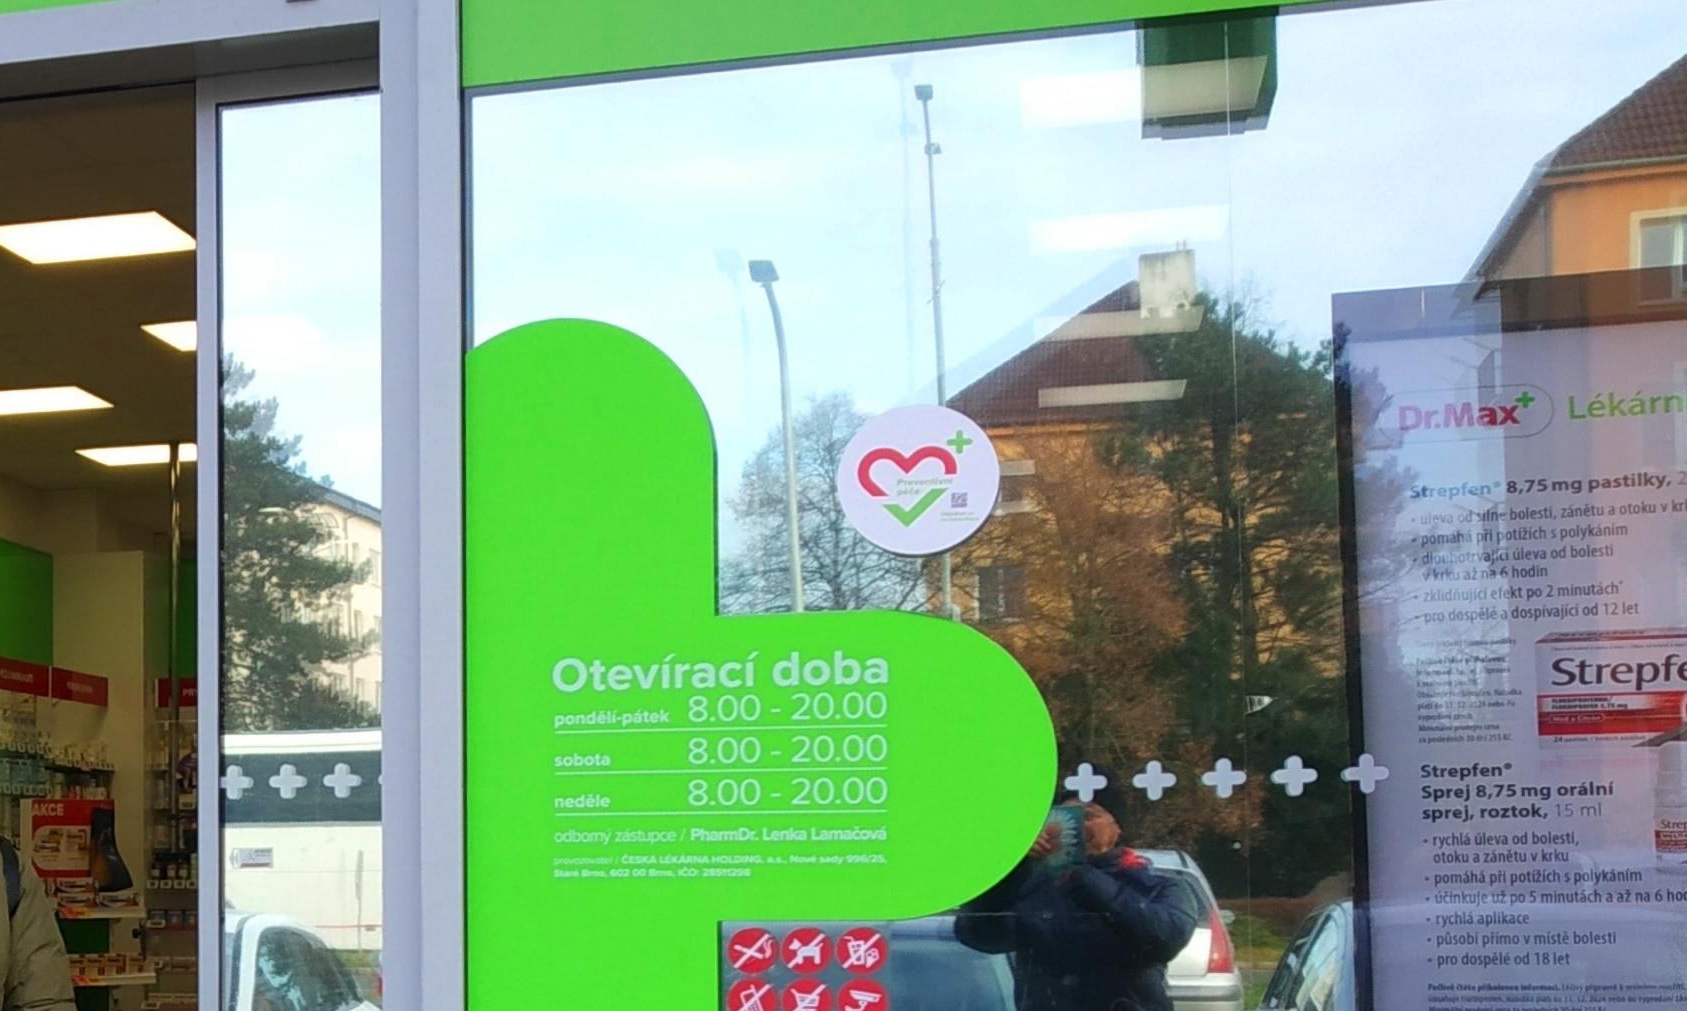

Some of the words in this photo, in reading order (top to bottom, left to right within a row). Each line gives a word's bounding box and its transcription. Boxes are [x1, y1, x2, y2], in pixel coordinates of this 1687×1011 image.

[1399, 402, 1521, 431] Dr.Max
[1506, 478, 1547, 495] 8,75
[1552, 480, 1582, 495] mg
[1588, 472, 1672, 492] pastilky,
[1509, 506, 1557, 522] bolesti,
[1560, 503, 1604, 518] zánětu
[1608, 506, 1615, 516] a
[1620, 501, 1656, 515] otoku
[1661, 503, 1668, 513] v
[1476, 528, 1493, 545] při
[1496, 527, 1546, 544] potížích
[1550, 529, 1557, 539] s
[1560, 523, 1628, 542] polykáním
[1512, 547, 1546, 560] úleva
[1550, 547, 1566, 559] od
[1570, 545, 1614, 558] bolesti
[1511, 564, 1548, 579] hodin
[1490, 585, 1522, 600] efekt
[1527, 587, 1542, 601] po
[1546, 584, 1554, 598] 2
[1511, 603, 1578, 621] dospívající
[1582, 603, 1598, 617] od
[1604, 603, 1618, 616] 12
[1622, 602, 1639, 616] let
[552, 652, 760, 693] Otevírací
[772, 650, 889, 687] doba
[554, 709, 670, 728] pondělí-pátek
[688, 694, 761, 723] 8.00
[791, 691, 887, 720] 20.00
[554, 753, 611, 767] sobota
[688, 736, 761, 764] 8.00
[791, 734, 887, 763] 20.00
[554, 794, 611, 809] neděle
[688, 778, 761, 806] 8.00
[791, 777, 887, 805] 20.00
[1421, 784, 1470, 803] Sprej
[1476, 784, 1517, 801] 8,75
[1521, 785, 1551, 801] mg
[1557, 781, 1614, 797] orální
[32, 803, 64, 816] AKCE
[1422, 805, 1474, 823] sprej,
[1480, 803, 1548, 820] roztok,
[1554, 803, 1573, 817] 15
[1580, 803, 1602, 817] ml
[762, 826, 808, 841] Lenka
[810, 825, 887, 841] Lamačová
[1433, 832, 1471, 848] rychlá
[1475, 831, 1508, 846] úleva
[1512, 831, 1528, 845] od
[1532, 831, 1579, 846] bolesti,
[1433, 850, 1469, 864] otoku
[1473, 853, 1480, 863] a
[1483, 849, 1527, 863] zánětu
[1530, 852, 1537, 862] v
[1541, 849, 1570, 862] krku
[1434, 870, 1486, 887] pomáhá
[1489, 870, 1507, 886] při
[1511, 869, 1561, 886] potížích
[1564, 872, 1571, 883] s
[1574, 868, 1642, 885] polykáním
[1435, 890, 1488, 906] účinkuje
[1492, 890, 1506, 904] už
[1510, 892, 1526, 906] po
[1529, 890, 1537, 903] 5
[1541, 889, 1605, 903] minutách
[1606, 892, 1613, 902] a
[1616, 888, 1631, 902] až
[1635, 891, 1650, 902] na
[1654, 889, 1663, 902] 6
[1435, 912, 1474, 928] rychlá
[1477, 912, 1530, 927] aplikace
[1436, 932, 1478, 948] působí
[1482, 931, 1520, 947] přímo
[1524, 935, 1531, 945] v
[1534, 931, 1570, 945] místě
[1573, 931, 1616, 945] bolesti
[1437, 955, 1457, 968] pro
[1461, 953, 1510, 968] dospělé
[1514, 953, 1530, 966] od
[1535, 953, 1550, 966] 18
[1553, 953, 1570, 966] let
